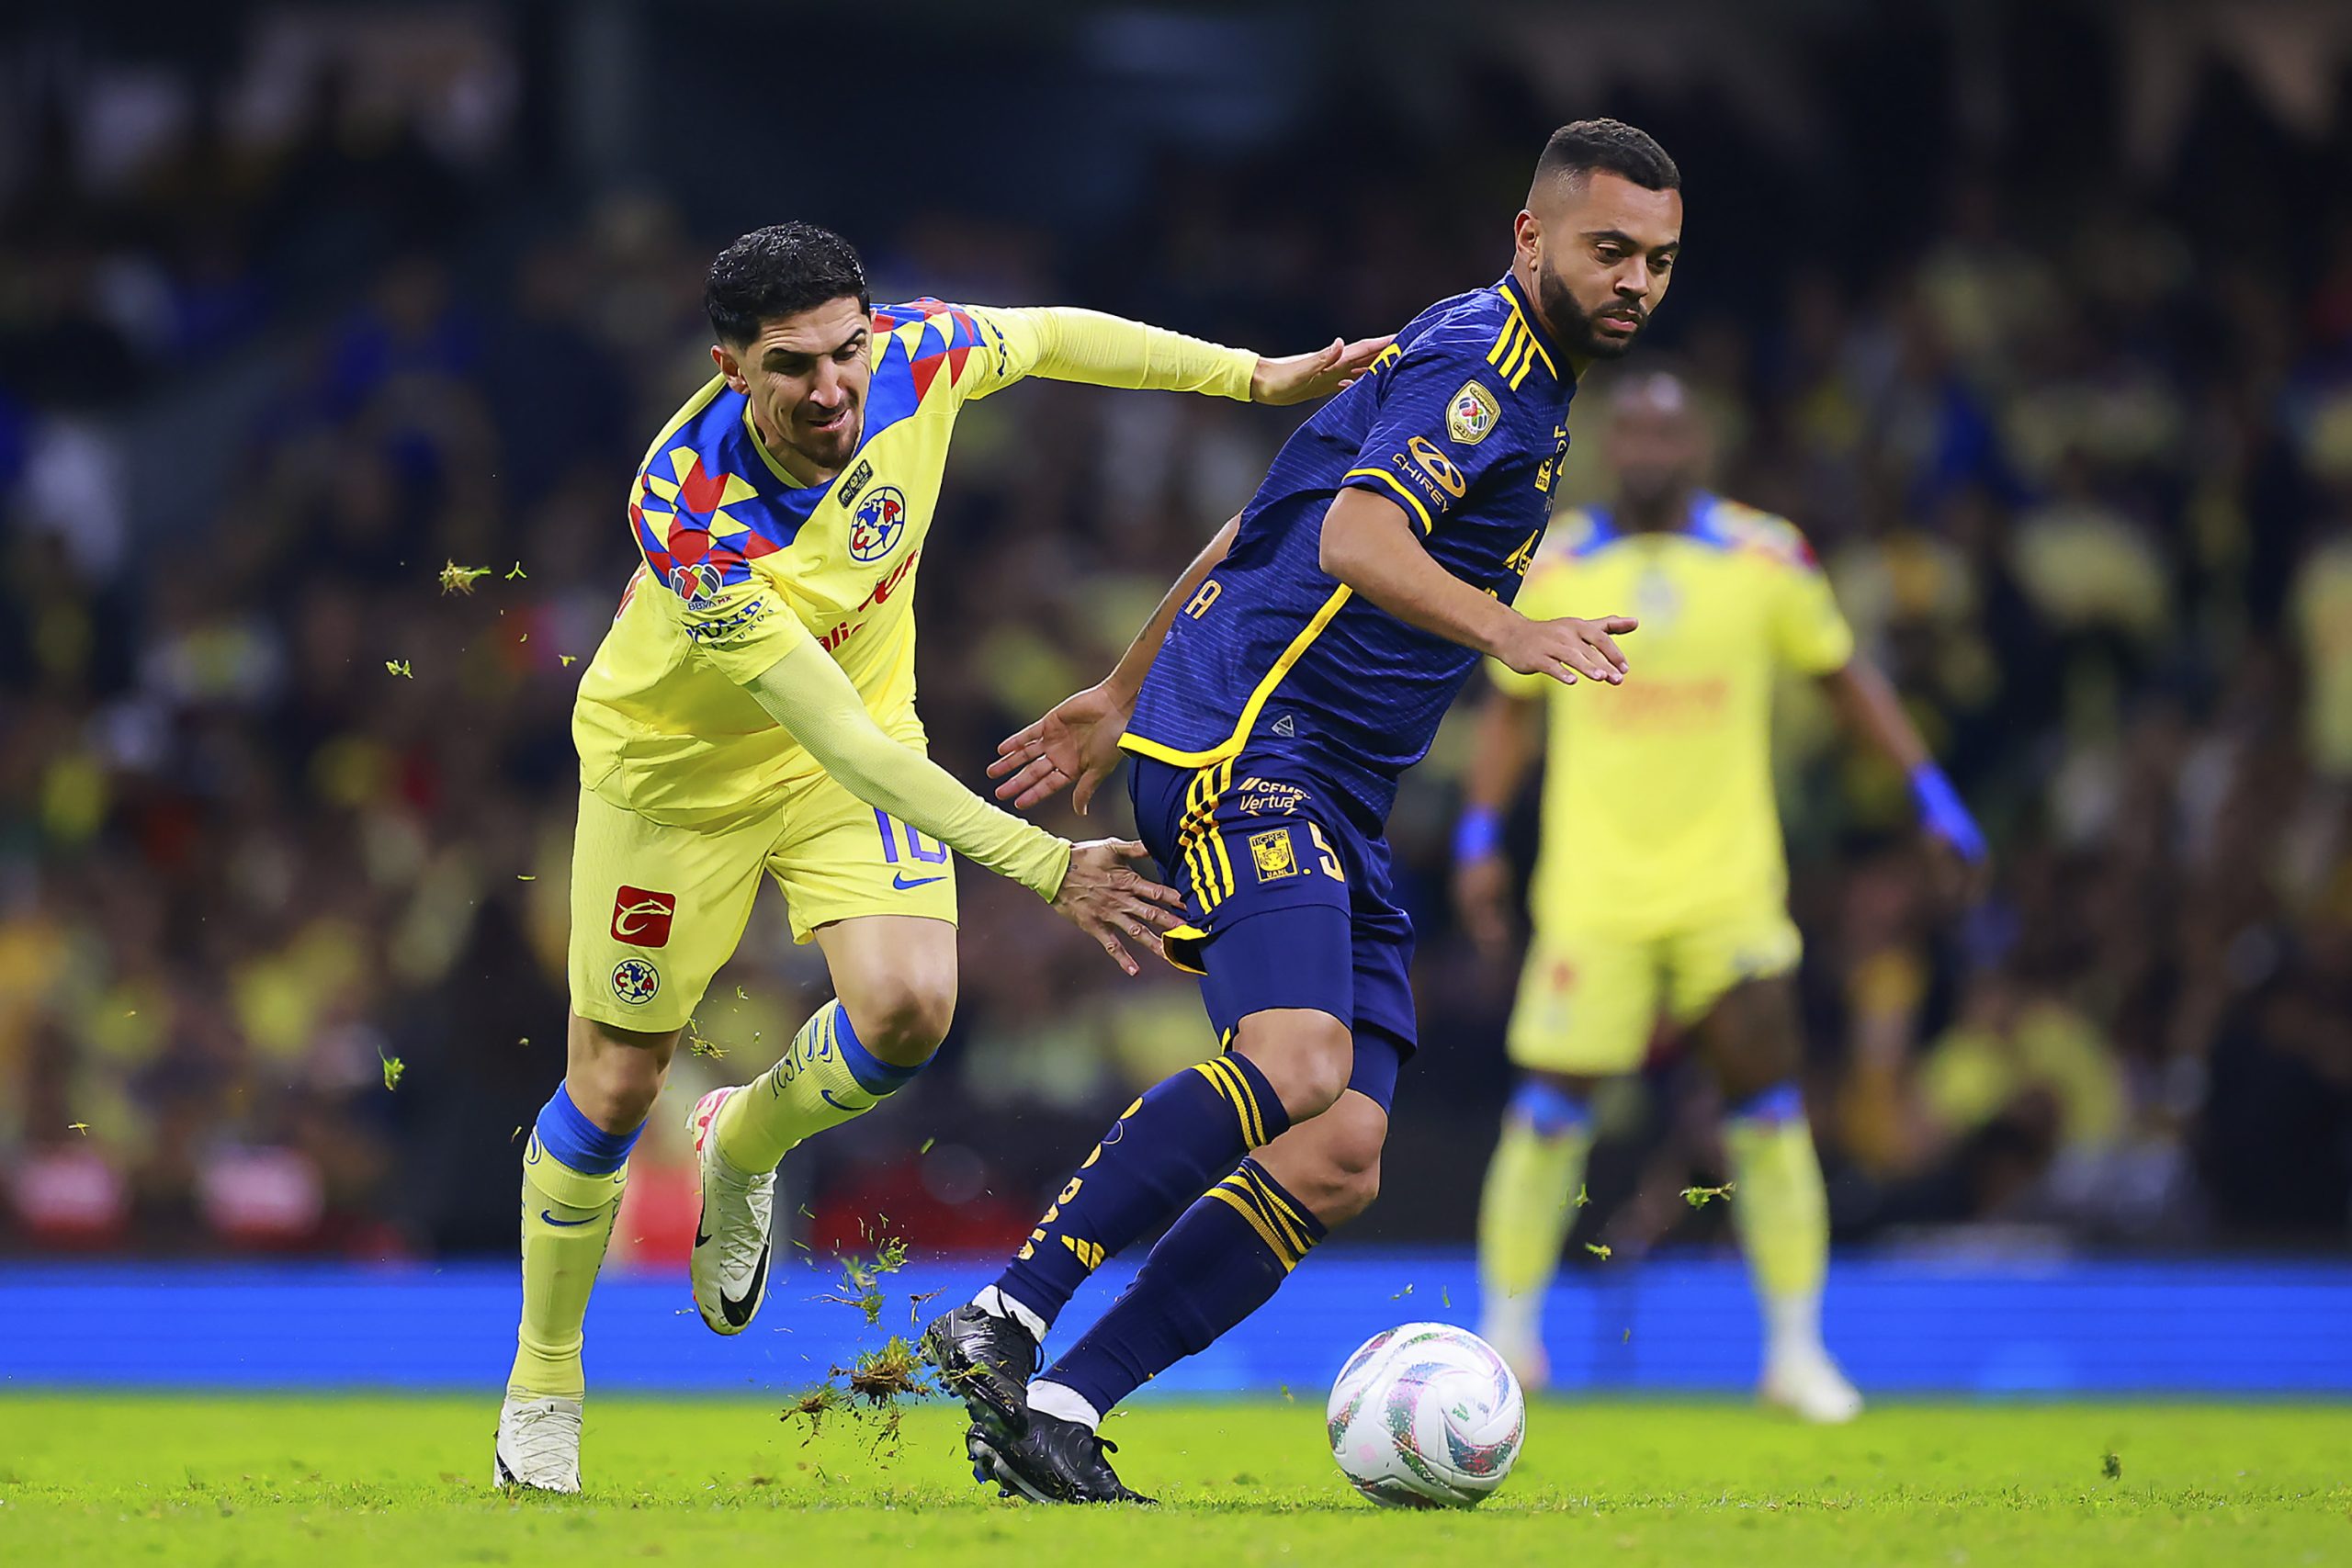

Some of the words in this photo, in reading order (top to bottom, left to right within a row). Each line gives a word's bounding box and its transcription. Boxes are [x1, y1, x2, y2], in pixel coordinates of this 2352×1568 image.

[1392, 453, 1450, 513] CHIREY
[688, 599, 718, 613] BBVA
[717, 593, 733, 604] MX
[1239, 794, 1295, 811] Vertua
[1252, 830, 1287, 847] TIGRES
